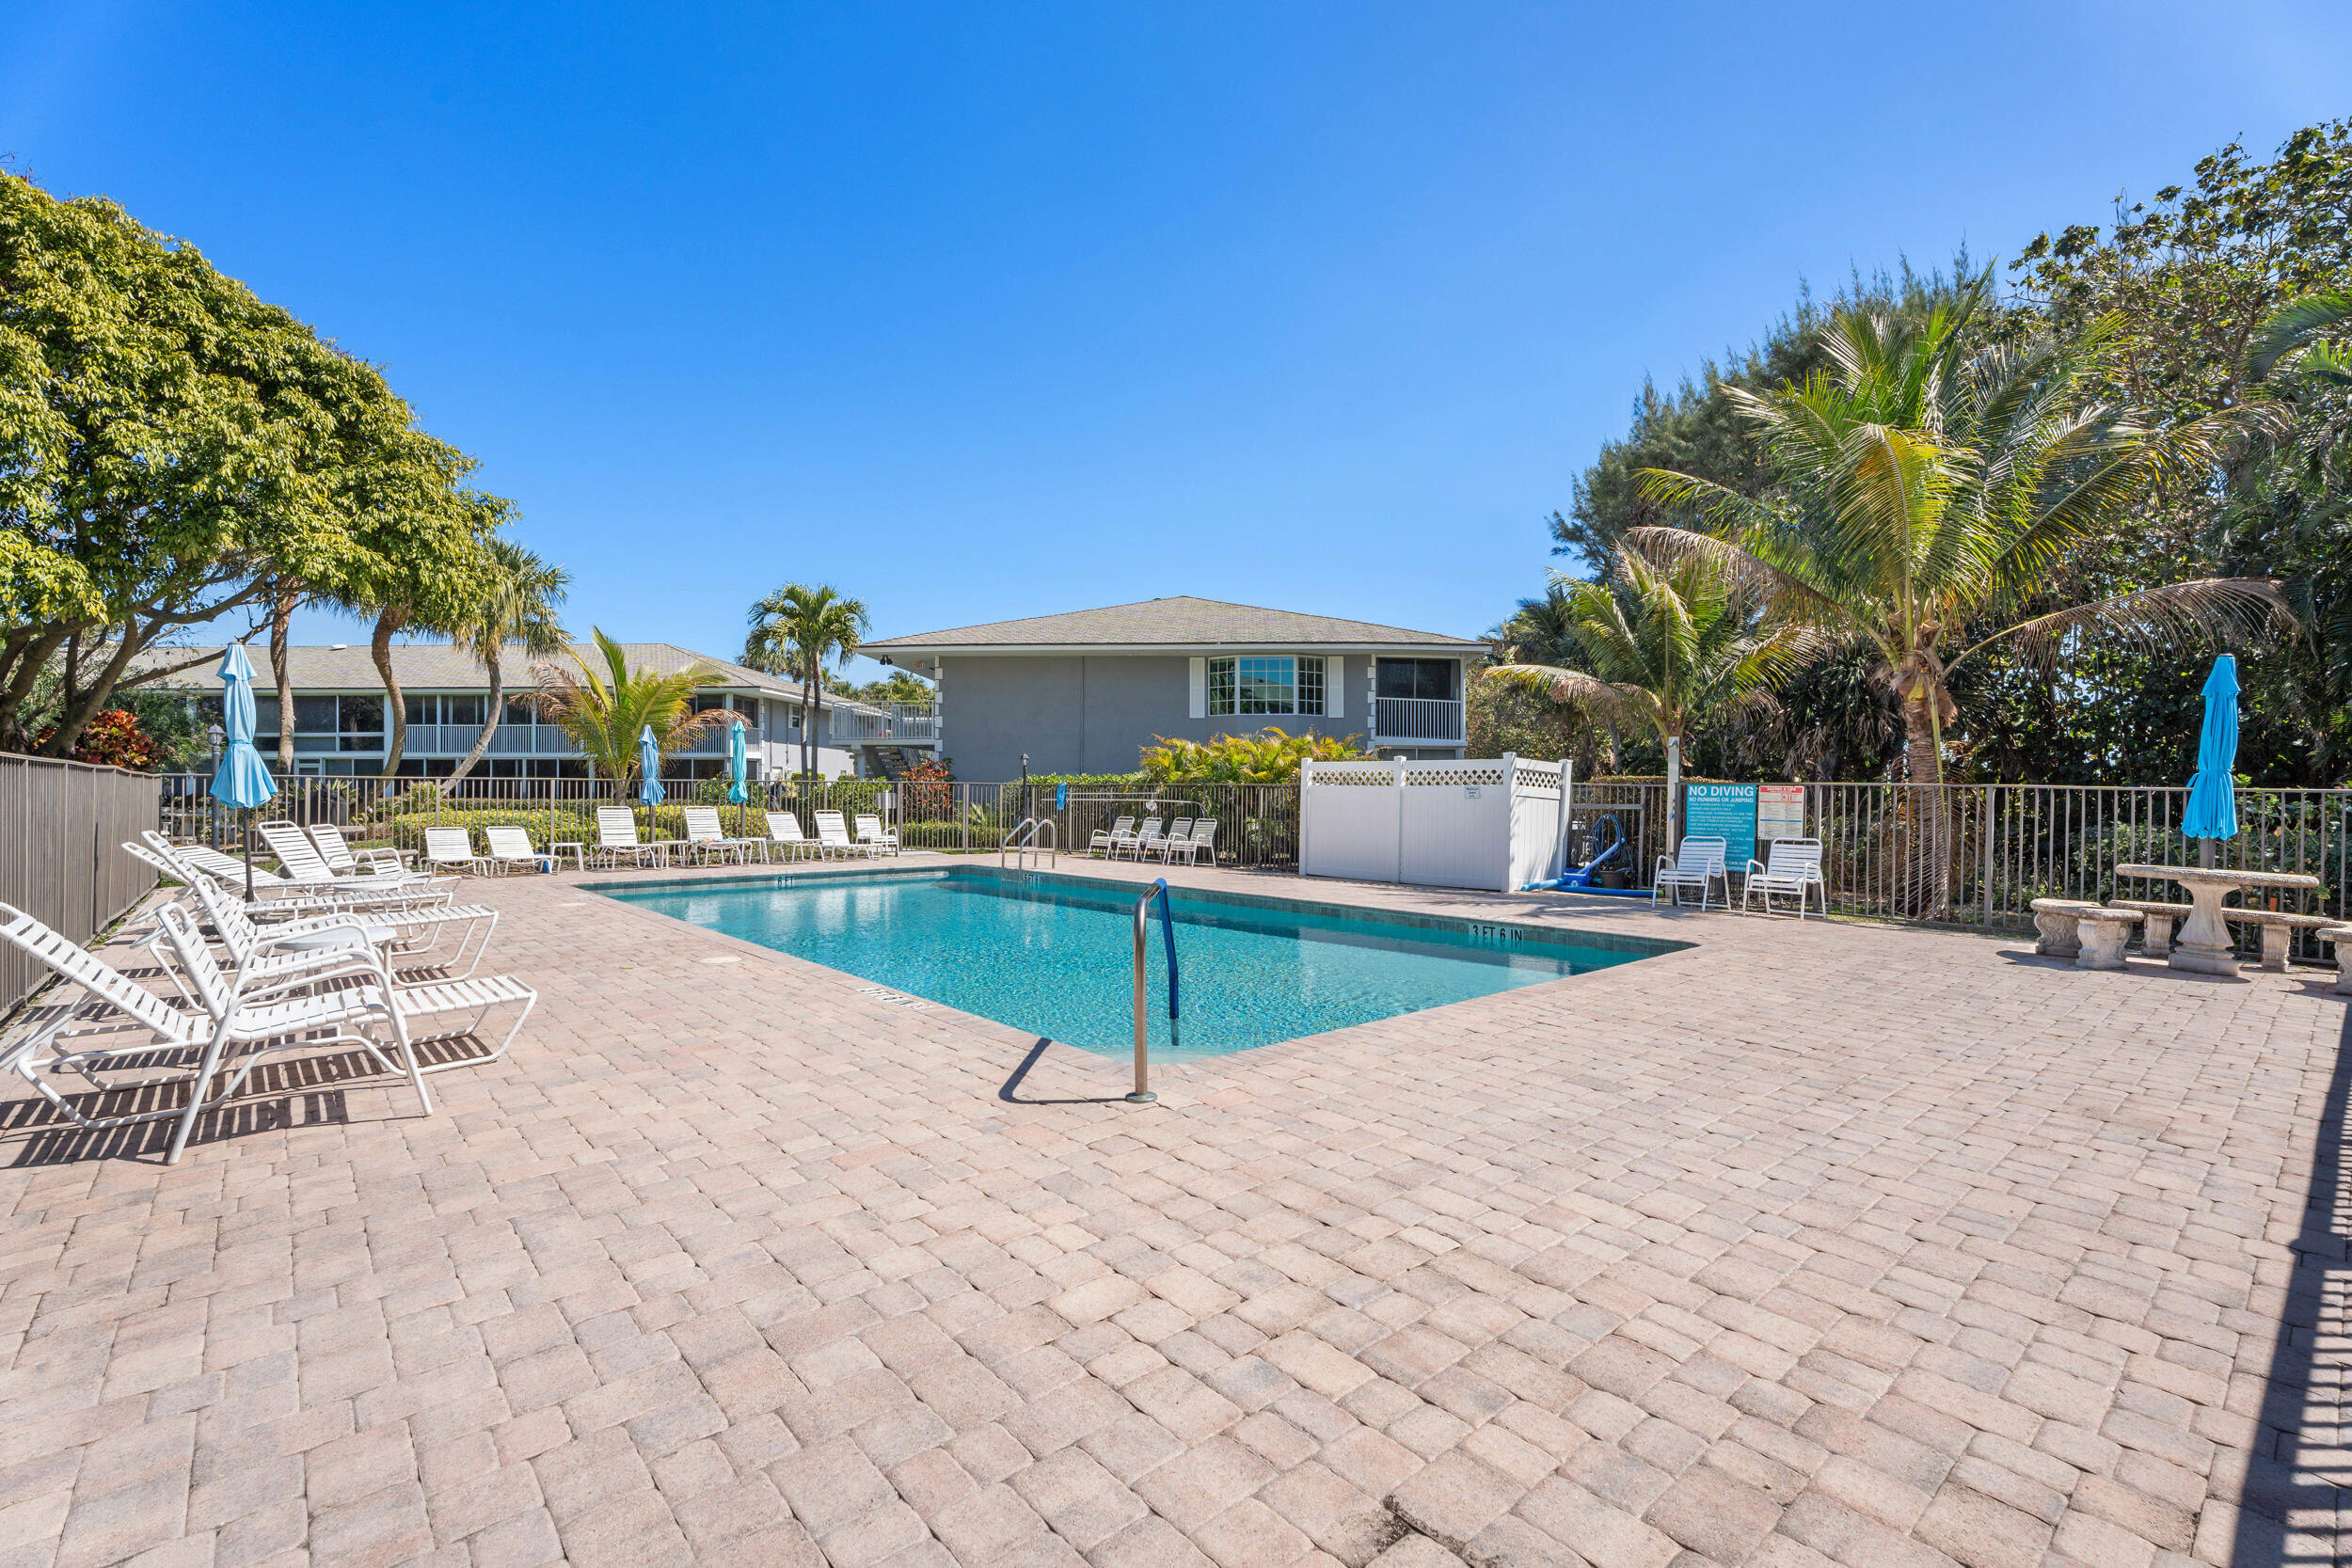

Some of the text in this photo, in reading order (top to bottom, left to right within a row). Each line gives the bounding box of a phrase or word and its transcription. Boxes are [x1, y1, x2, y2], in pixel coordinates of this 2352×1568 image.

[1689, 786, 1755, 797] NO DIVING
[785, 877, 793, 887] FT
[1472, 925, 1522, 941] 3 FT 6 IN
